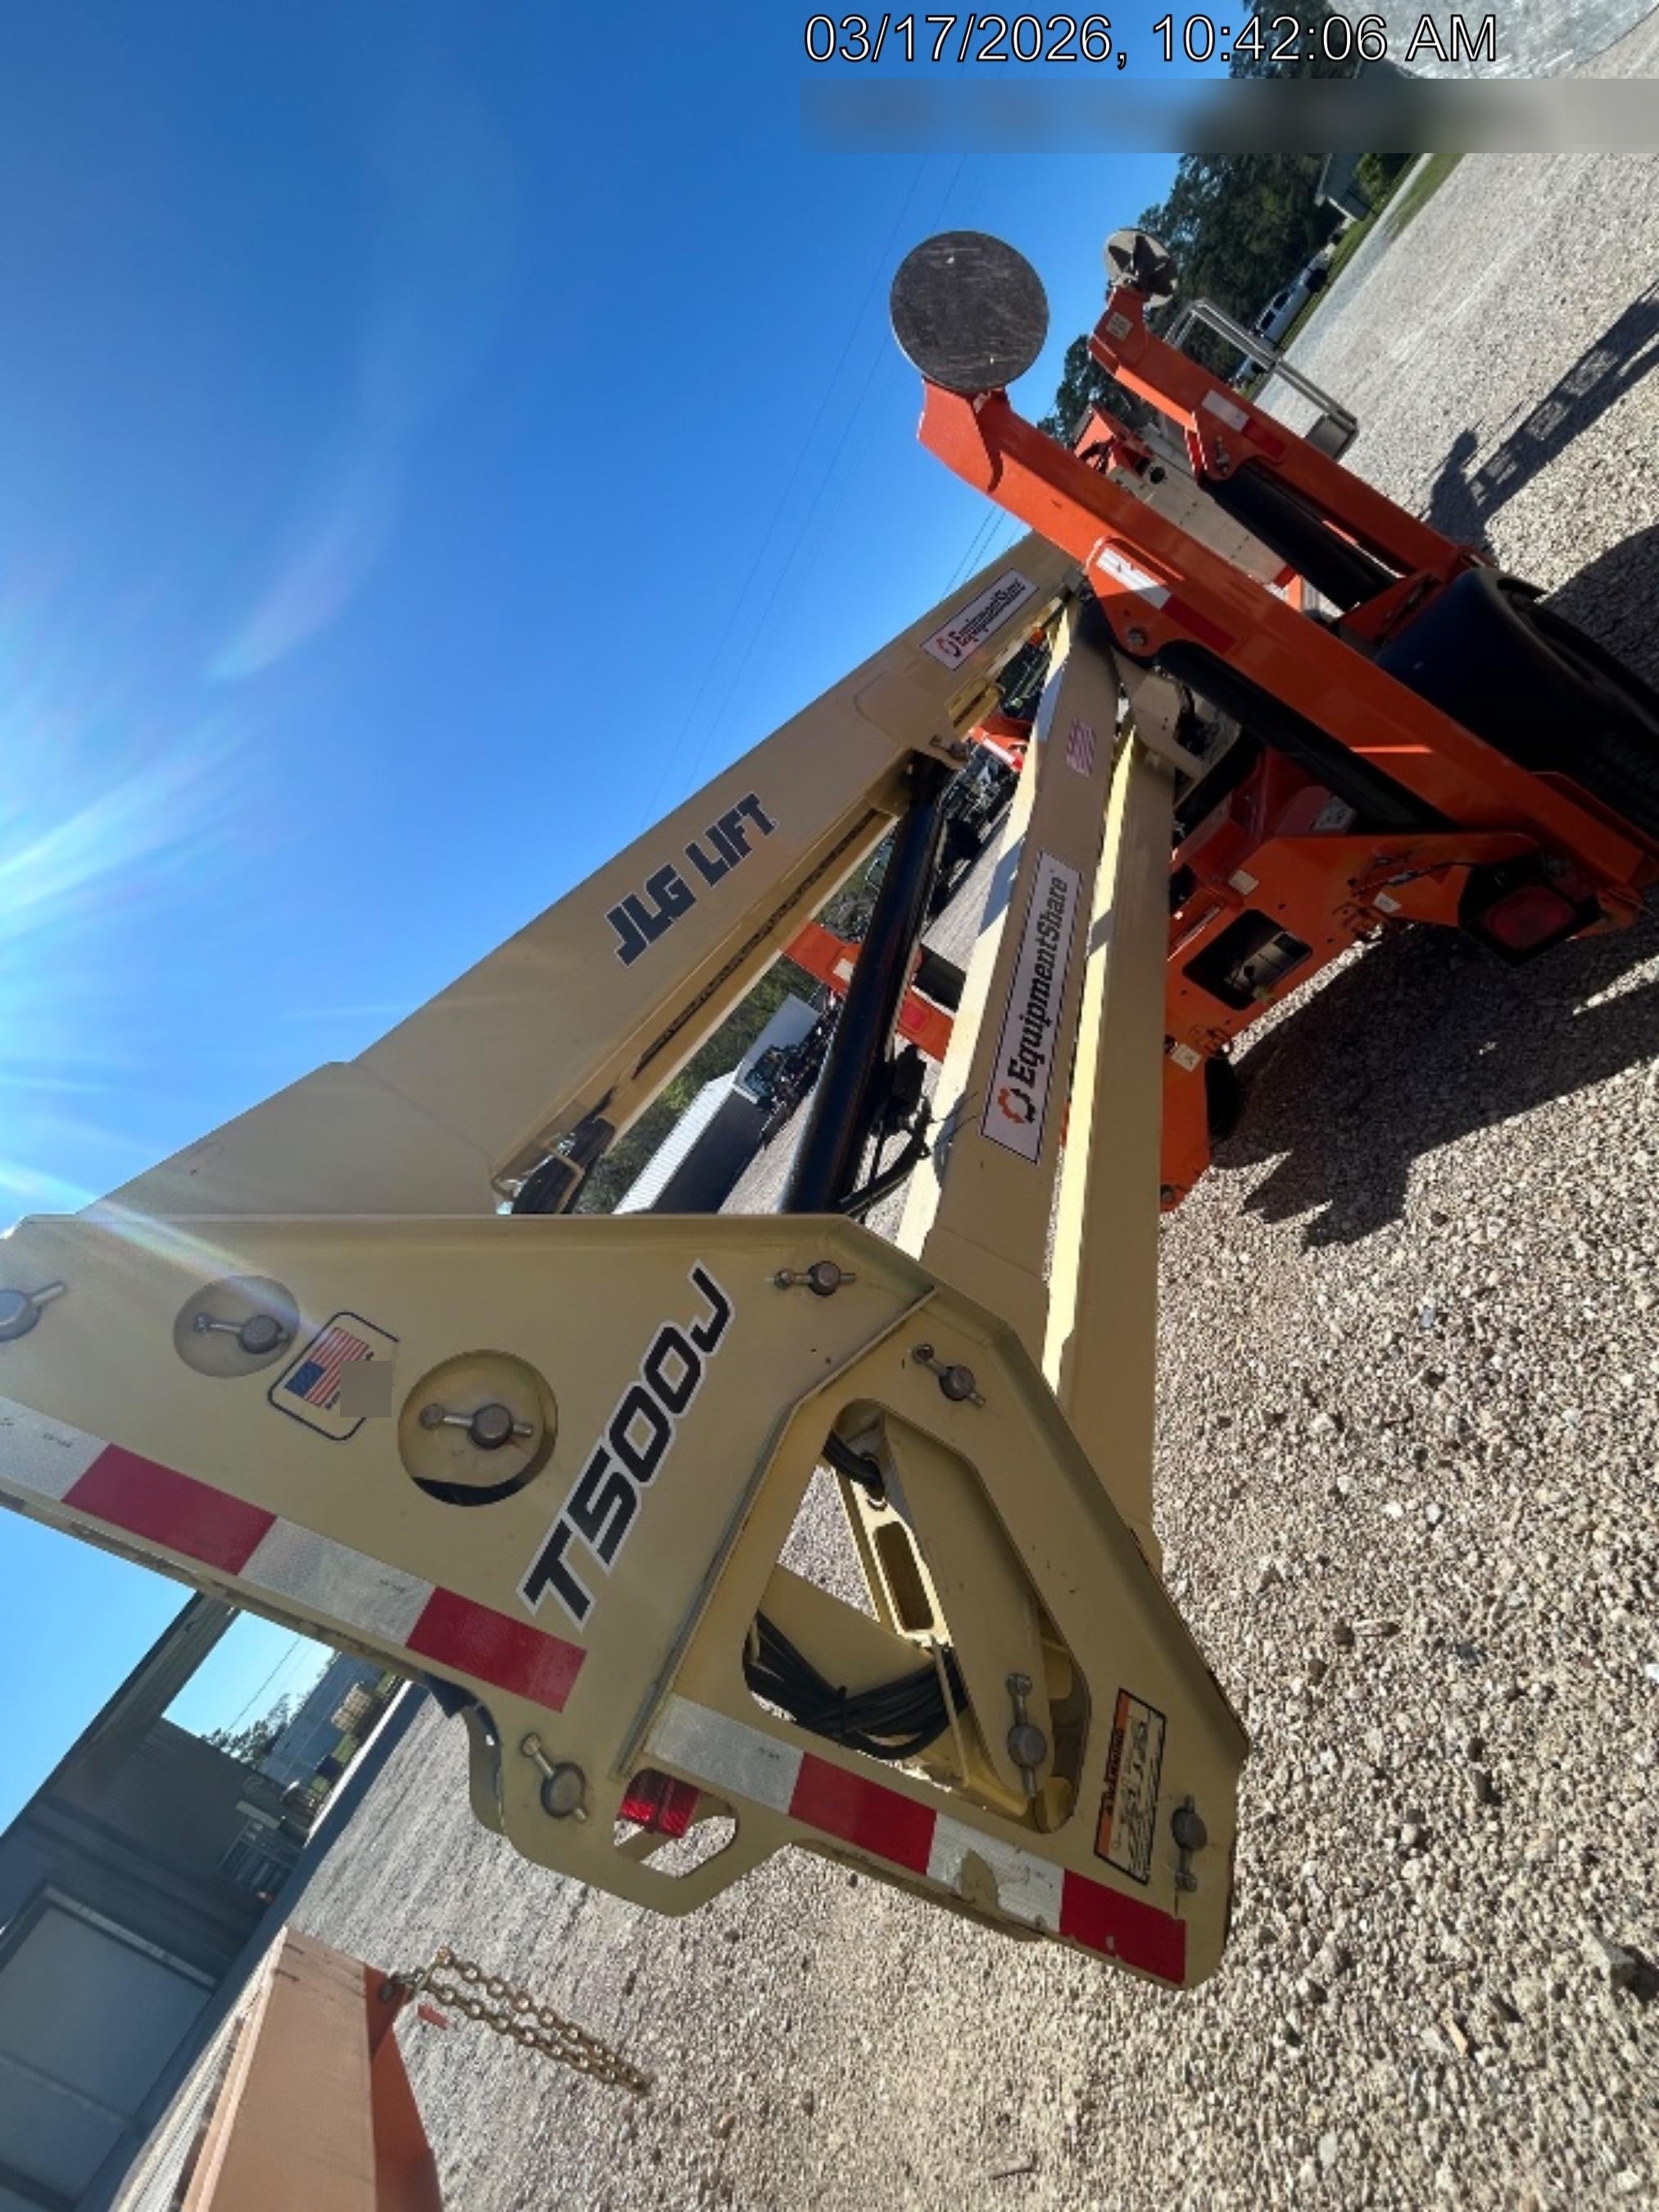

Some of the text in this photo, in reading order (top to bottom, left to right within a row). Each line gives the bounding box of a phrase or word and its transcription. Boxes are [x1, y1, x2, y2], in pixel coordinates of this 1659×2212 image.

[948, 578, 1026, 647] EquipmentShare
[604, 791, 777, 968] JLG LIFT
[1007, 875, 1068, 1090] EquipmentShare
[518, 1260, 734, 1631] T500J
